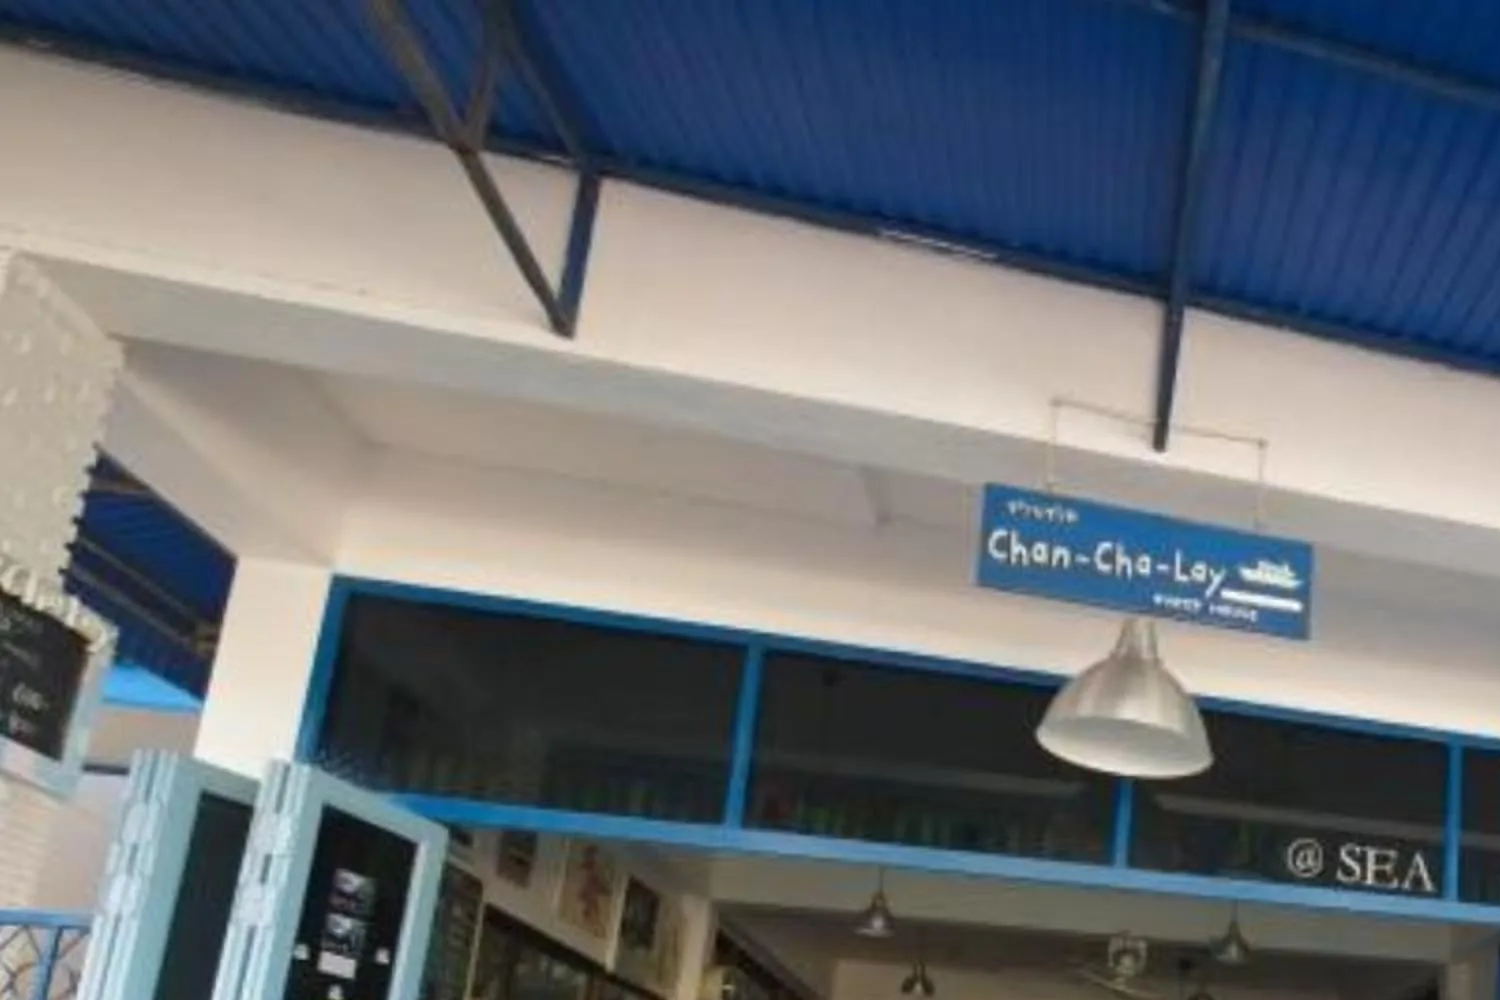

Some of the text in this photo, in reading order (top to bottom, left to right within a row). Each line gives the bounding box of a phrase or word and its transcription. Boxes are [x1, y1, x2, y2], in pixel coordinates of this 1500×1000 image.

[987, 528, 1228, 599] Chan-Cha-Lay
[1287, 838, 1434, 892] @ SEA
